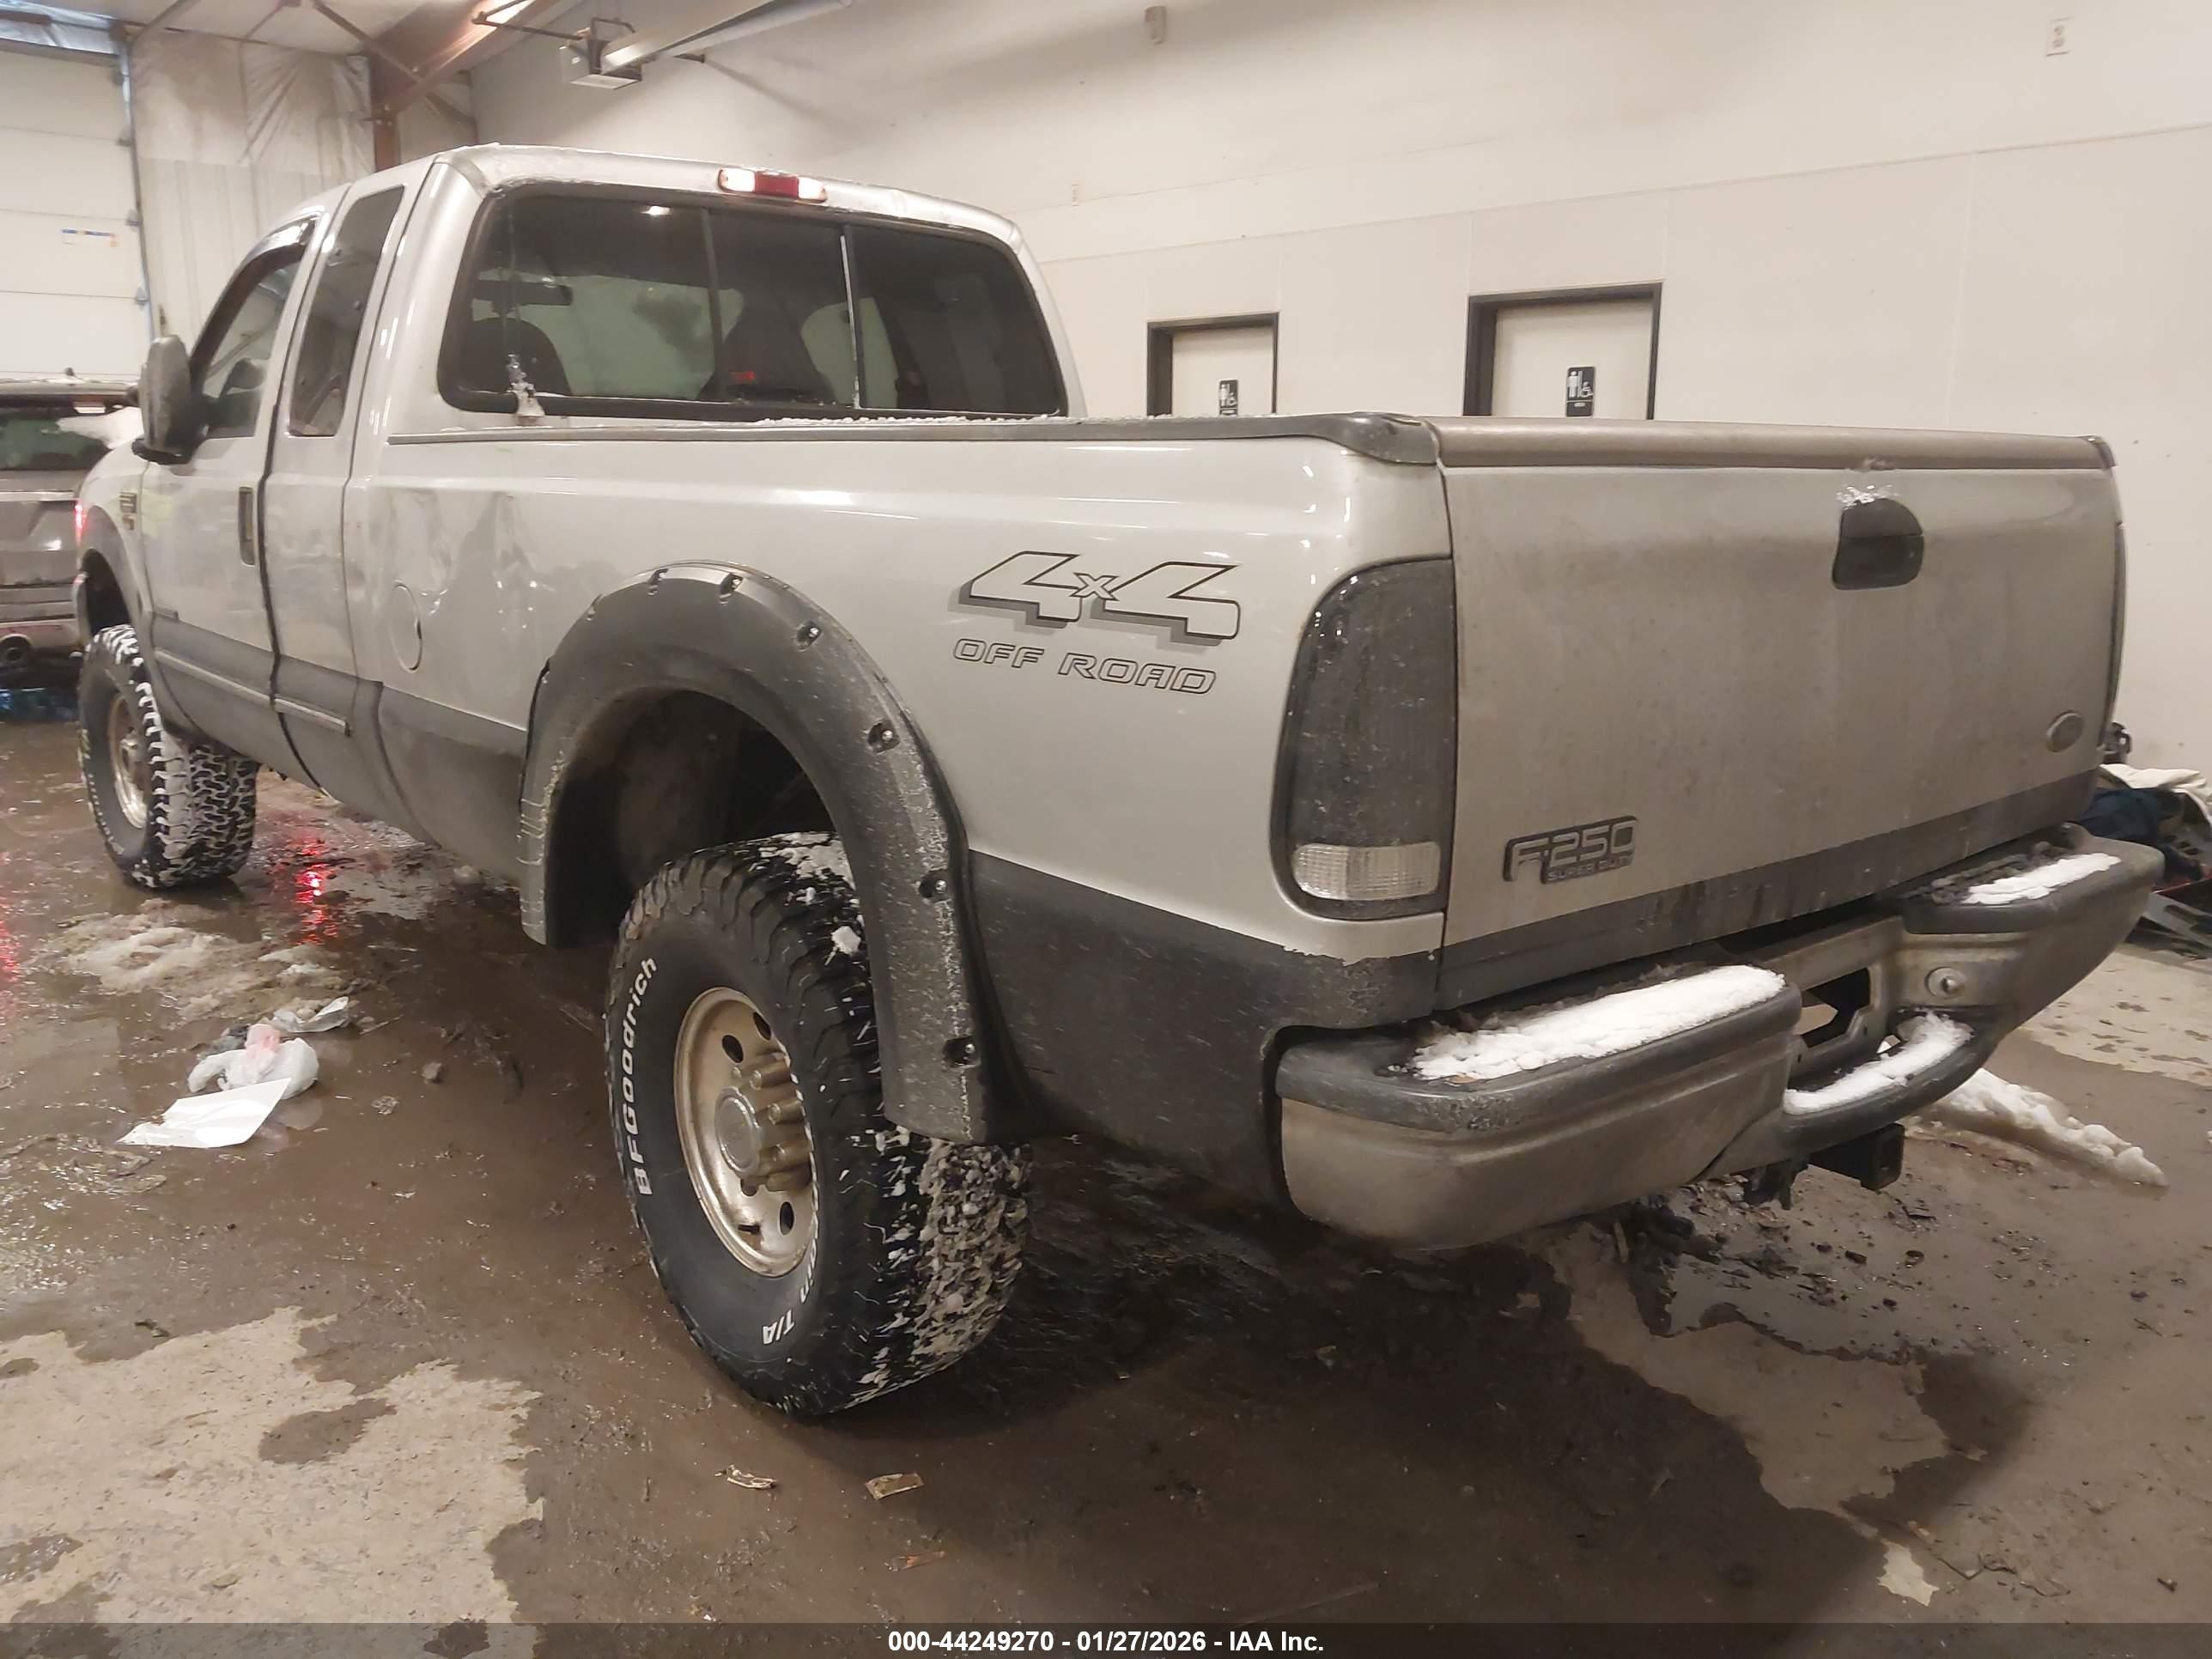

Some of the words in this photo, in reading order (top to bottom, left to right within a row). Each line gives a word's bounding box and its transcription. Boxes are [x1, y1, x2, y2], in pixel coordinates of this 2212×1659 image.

[953, 638, 1044, 668] OFF
[1058, 653, 1216, 694] ROAD
[763, 1309, 794, 1344] T/A
